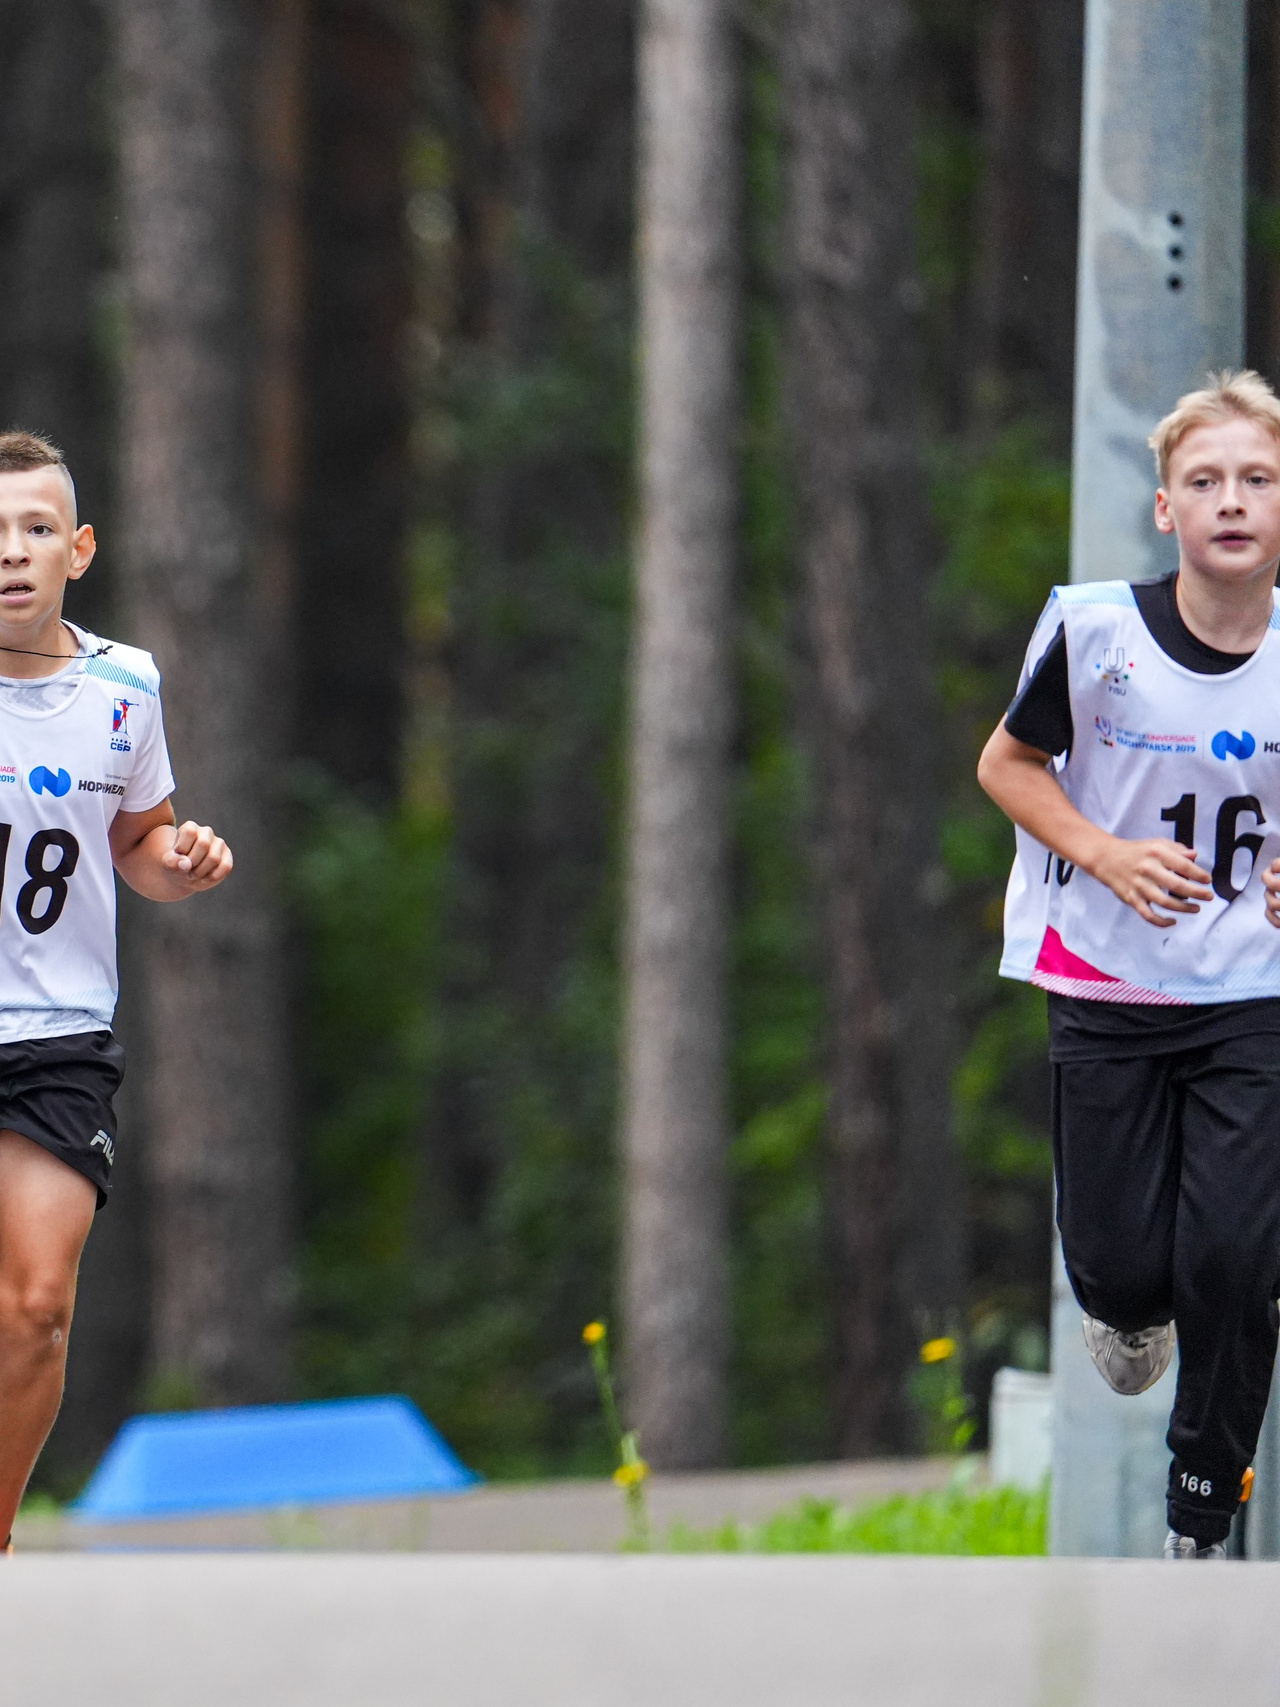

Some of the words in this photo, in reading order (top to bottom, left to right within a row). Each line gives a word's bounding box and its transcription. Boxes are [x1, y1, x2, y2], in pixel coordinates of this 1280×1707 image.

[110, 742, 131, 752] СБР
[1160, 793, 1266, 904] 16
[1180, 1472, 1212, 1496] 166
